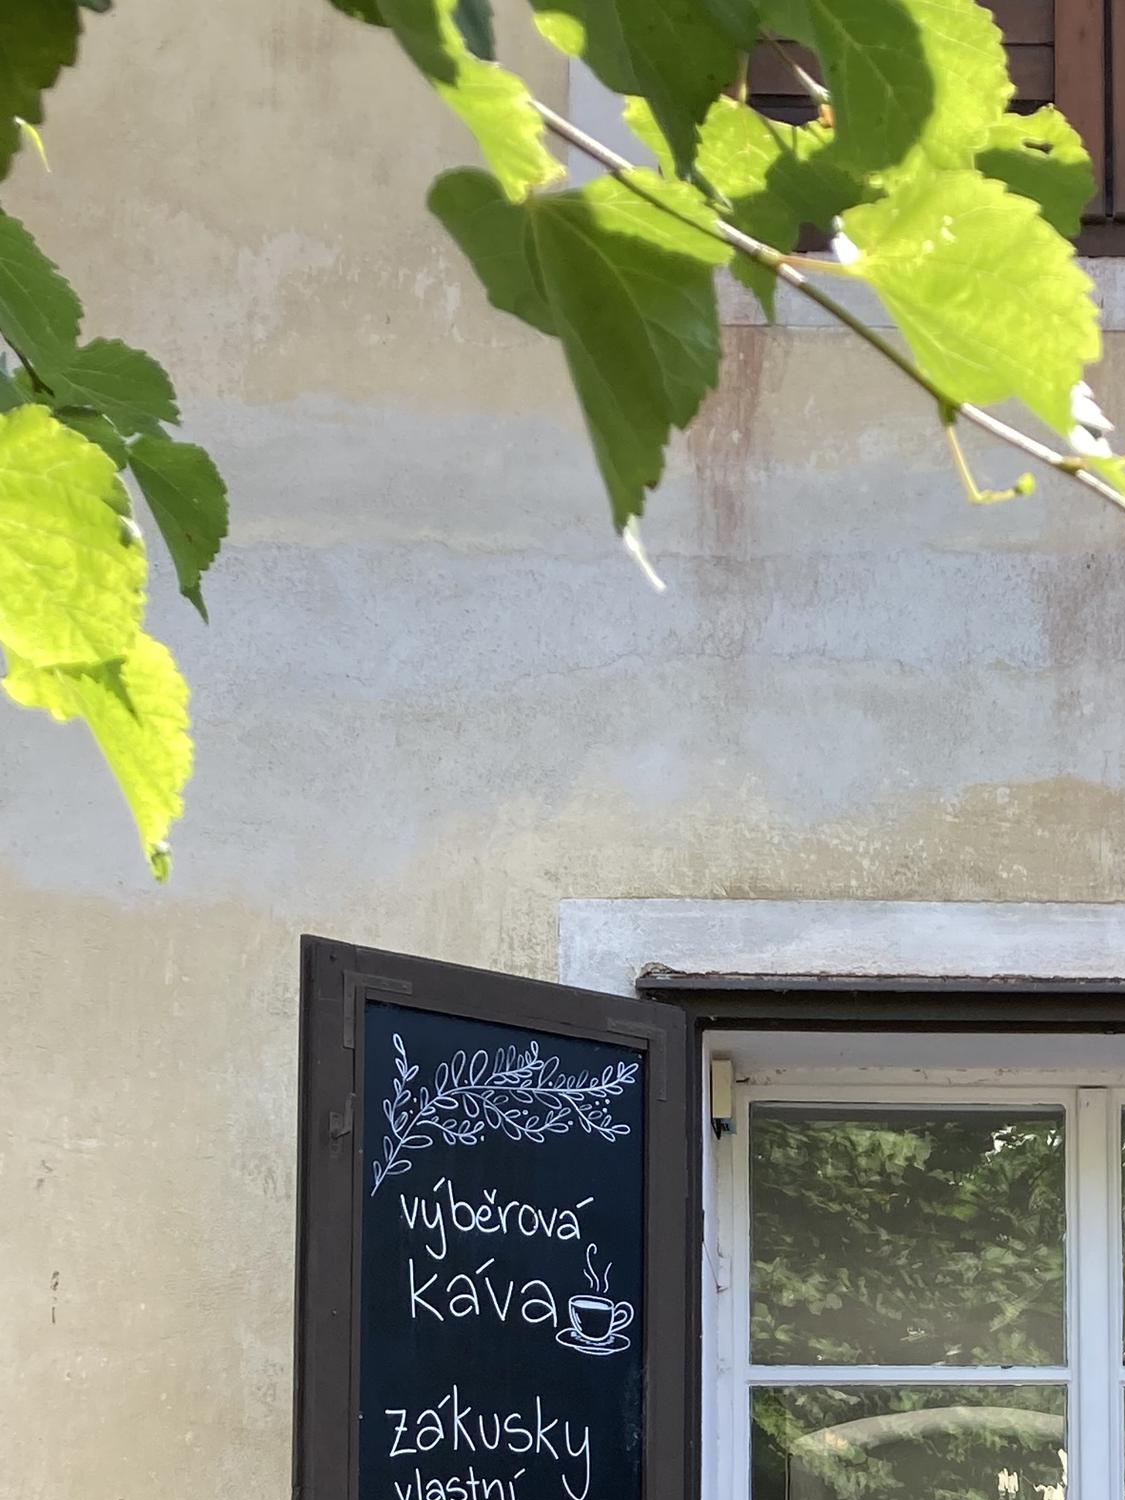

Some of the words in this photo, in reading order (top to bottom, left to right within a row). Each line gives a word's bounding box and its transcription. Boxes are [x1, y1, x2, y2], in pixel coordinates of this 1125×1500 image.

[401, 1177, 594, 1260] výběrová
[408, 1257, 558, 1328] káva
[385, 1384, 591, 1500] zákusky
